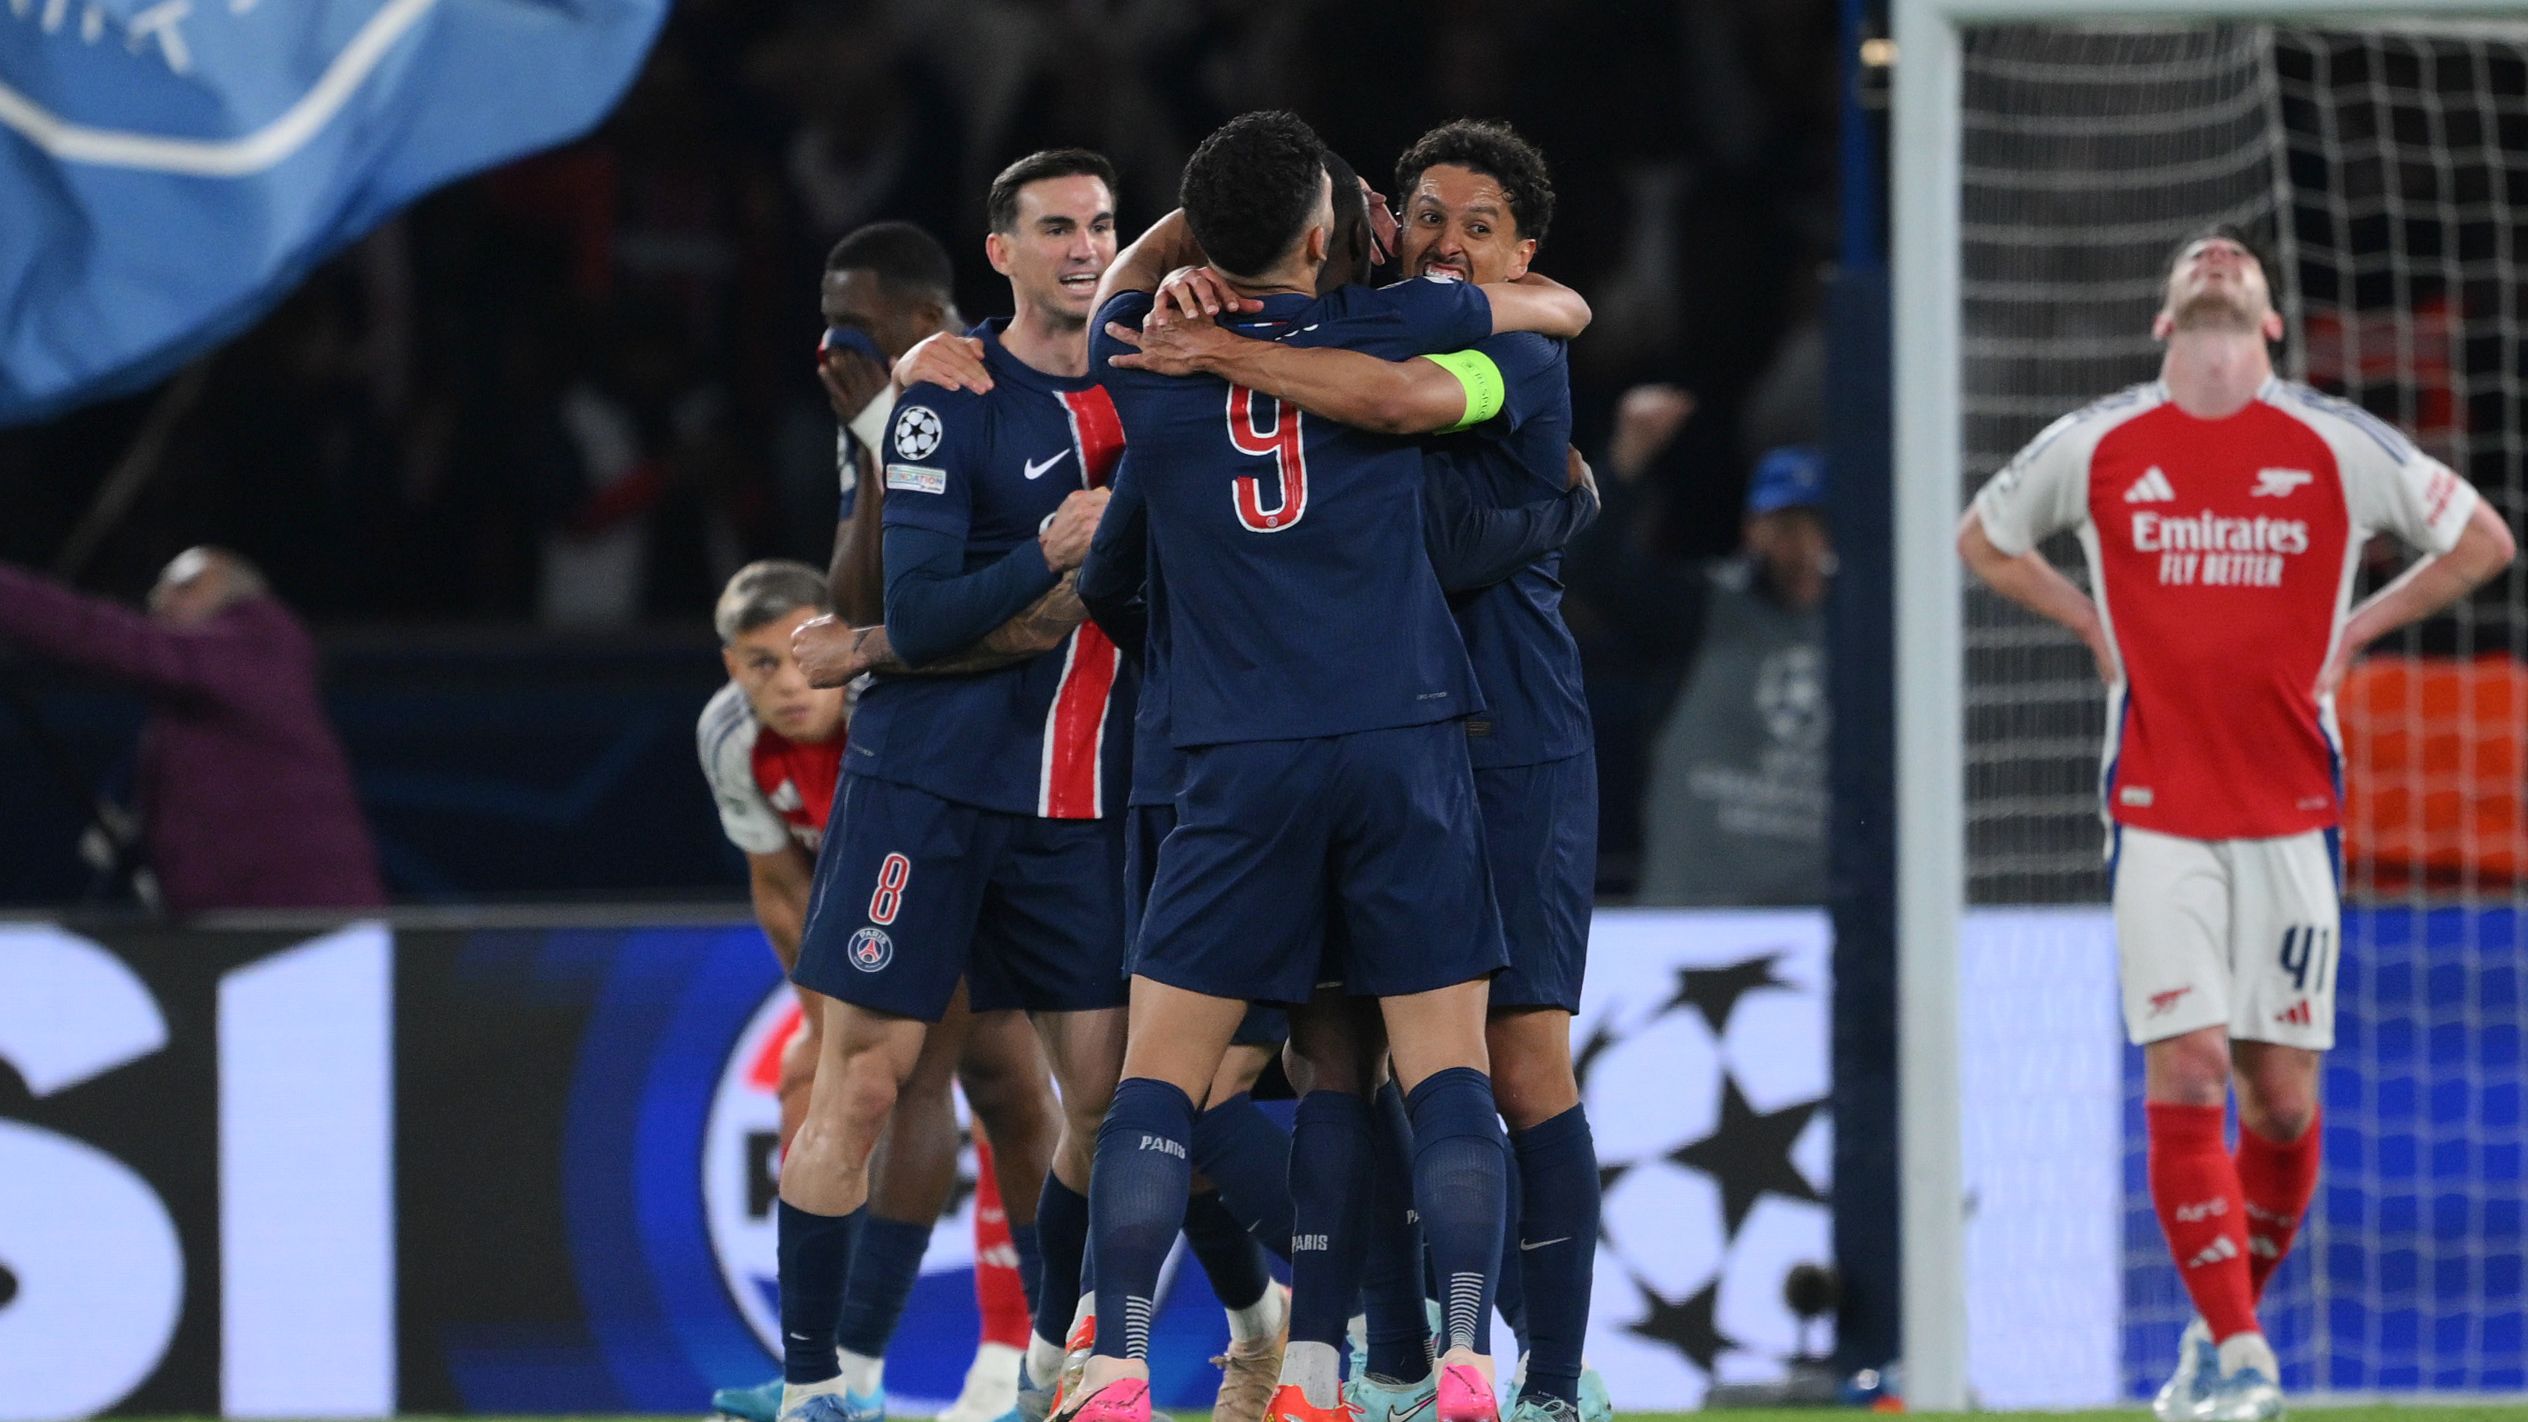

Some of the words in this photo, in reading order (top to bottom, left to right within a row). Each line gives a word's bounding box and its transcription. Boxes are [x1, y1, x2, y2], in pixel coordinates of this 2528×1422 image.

[1226, 383, 1309, 533] 9
[2132, 508, 2309, 554] Emirates
[2159, 552, 2198, 585] FLY
[2202, 553, 2285, 587] BETTER
[868, 852, 910, 925] 8
[859, 930, 886, 945] PARIS
[2280, 926, 2328, 993] 41
[1139, 1135, 1186, 1159] PARIS
